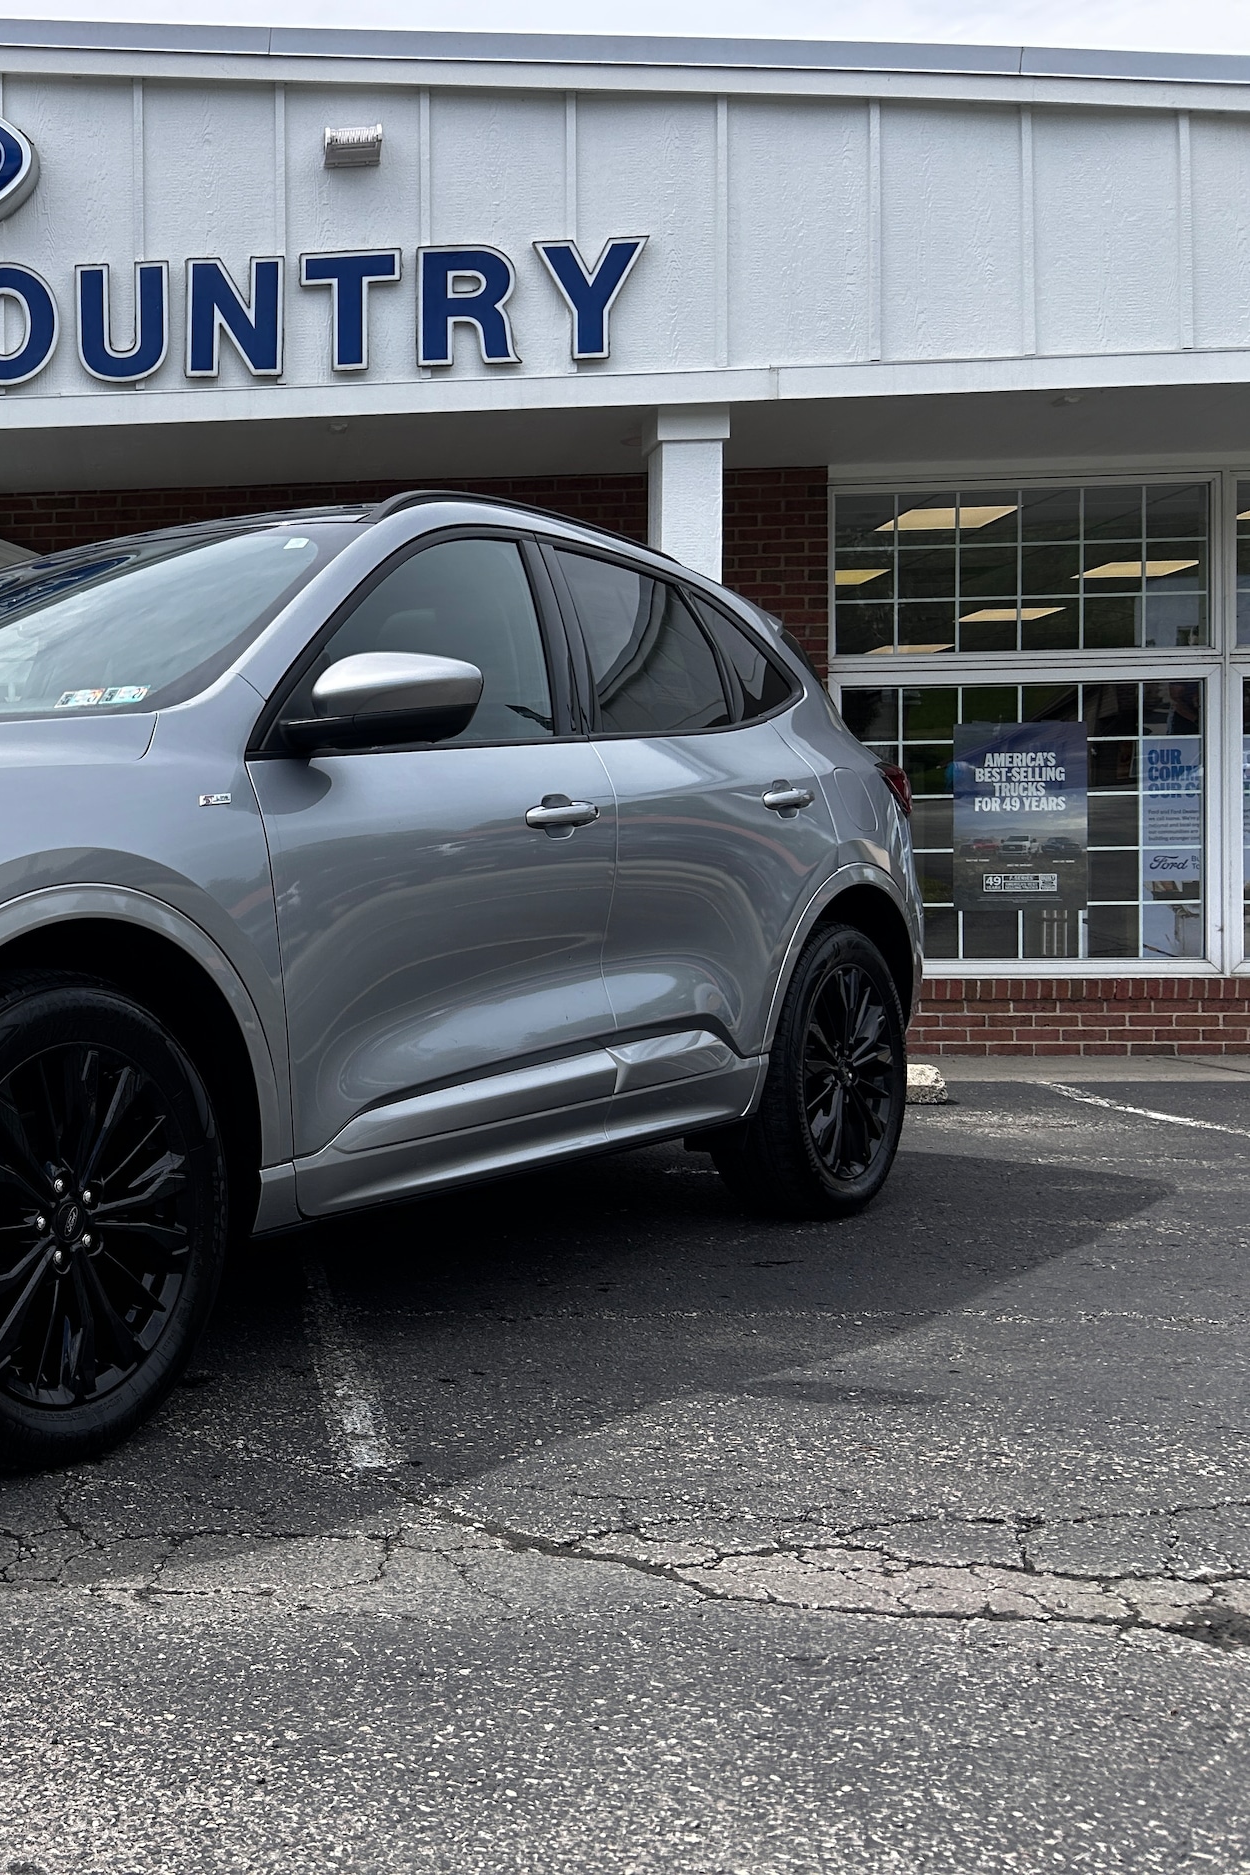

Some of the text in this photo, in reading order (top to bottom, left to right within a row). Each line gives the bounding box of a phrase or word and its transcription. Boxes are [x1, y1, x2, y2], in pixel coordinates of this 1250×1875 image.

[984, 752, 1057, 767] AMERICA'S
[1148, 749, 1182, 765] OUR
[974, 767, 1066, 782] BEST-SELLING
[993, 782, 1046, 797] TRUCKS
[974, 796, 1066, 812] FOR 49 YEARS
[1150, 855, 1188, 870] Ford
[985, 876, 1001, 886] 49
